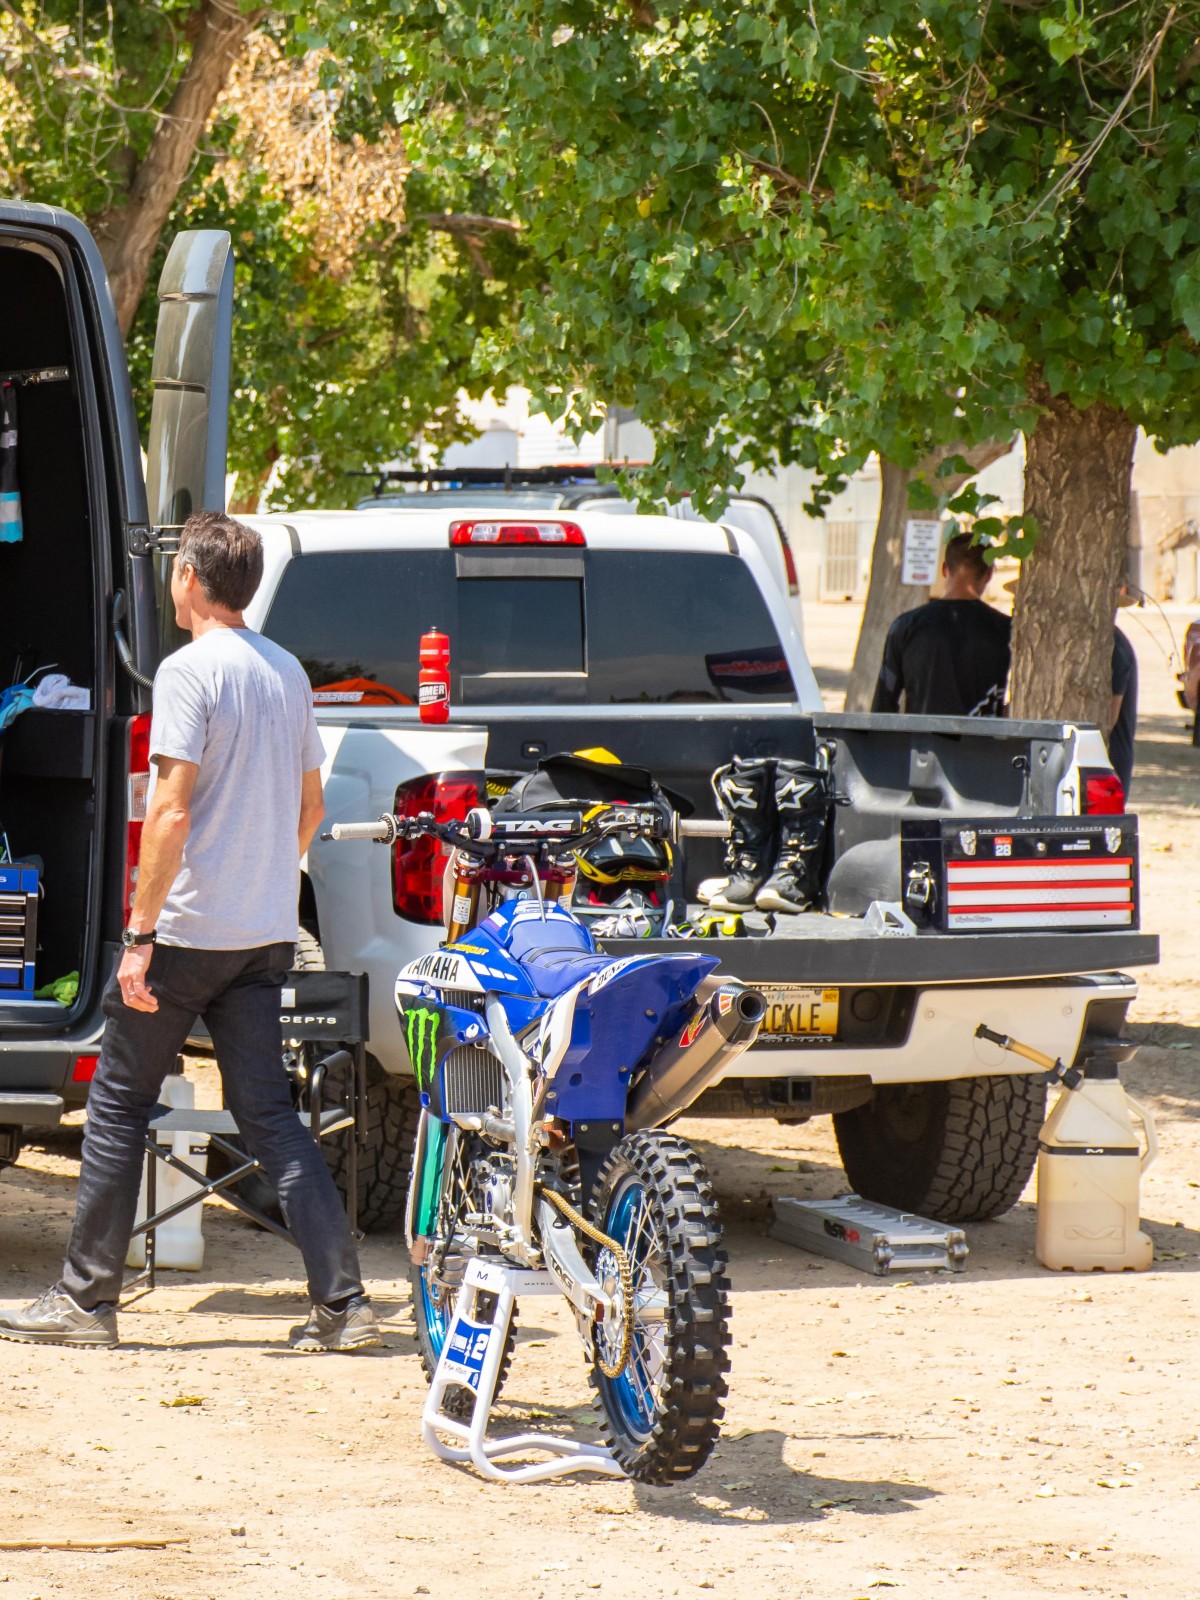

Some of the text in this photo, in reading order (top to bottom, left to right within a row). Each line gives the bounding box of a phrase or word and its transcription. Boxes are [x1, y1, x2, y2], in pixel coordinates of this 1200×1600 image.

[496, 819, 574, 832] TAG
[995, 844, 1012, 857] 28
[406, 954, 460, 983] YAMAHA
[471, 1332, 490, 1361] 2
